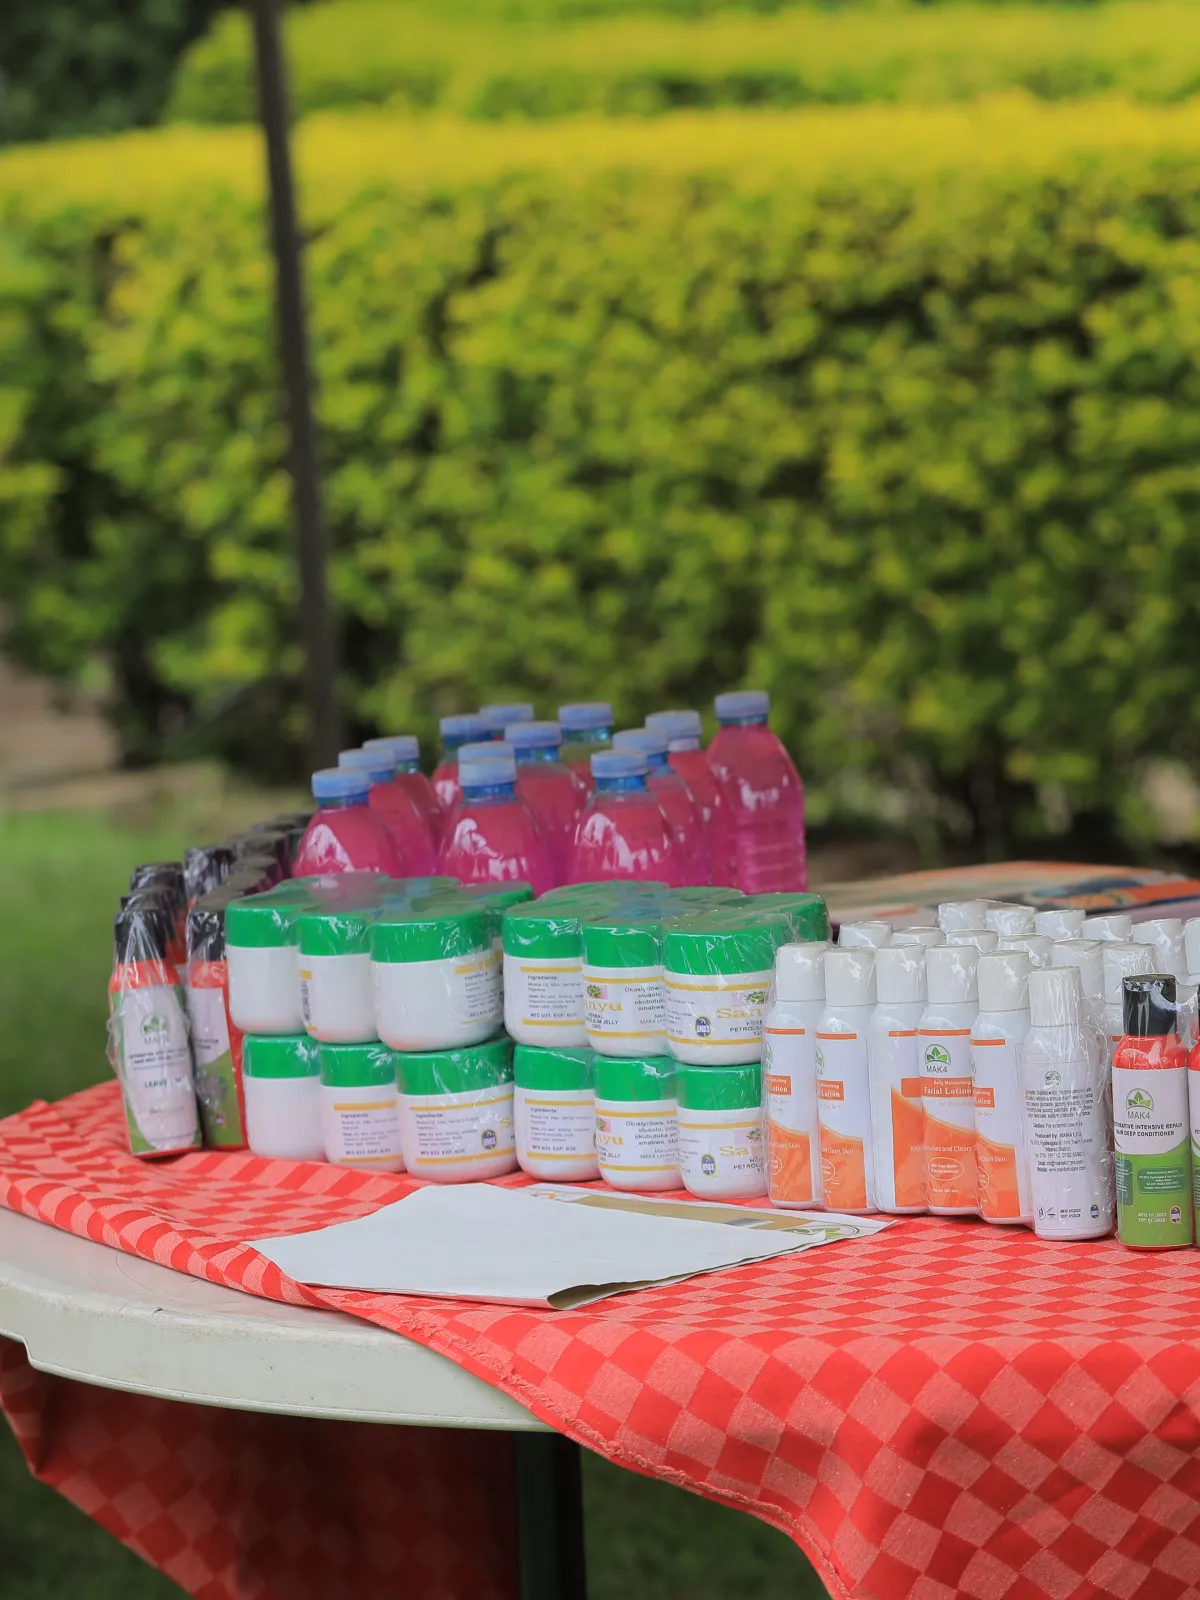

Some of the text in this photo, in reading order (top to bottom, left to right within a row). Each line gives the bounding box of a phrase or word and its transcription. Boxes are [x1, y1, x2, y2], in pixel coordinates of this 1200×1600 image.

[926, 1065, 948, 1074] MAK4
[924, 1087, 943, 1095] Facial
[945, 1087, 972, 1095] Lotion
[1127, 1110, 1151, 1120] MAK4
